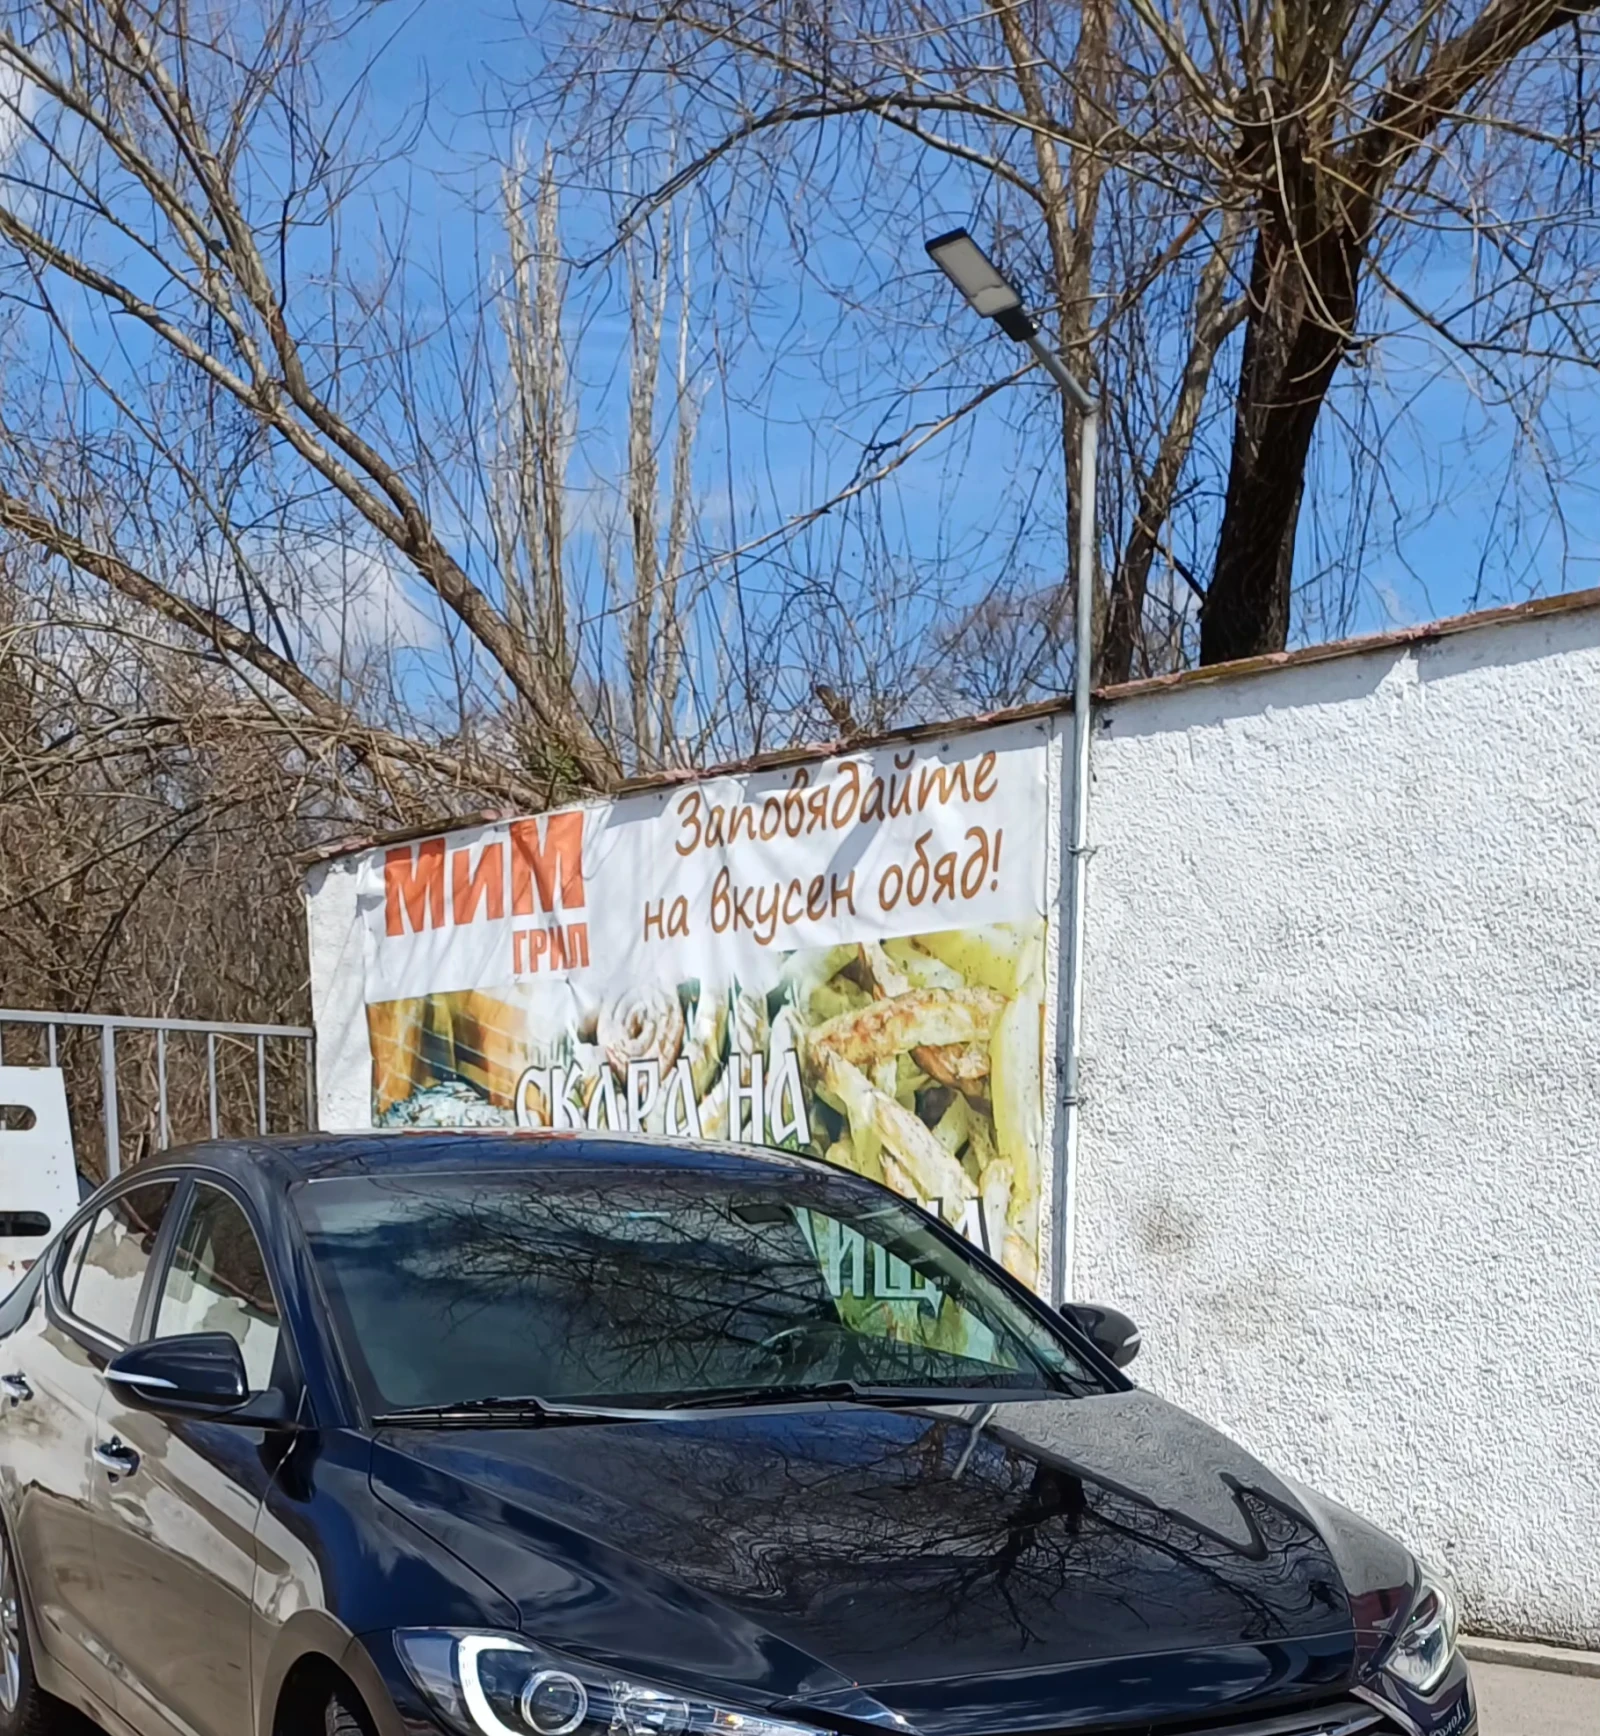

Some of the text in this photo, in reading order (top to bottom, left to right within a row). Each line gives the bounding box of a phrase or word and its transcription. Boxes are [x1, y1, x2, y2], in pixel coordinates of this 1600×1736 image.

[675, 750, 998, 856] Заповядайте
[644, 827, 1003, 945] на вкусен обяд!
[512, 922, 590, 974] ГРИЛ
[514, 1047, 811, 1144] СКАРА НА
